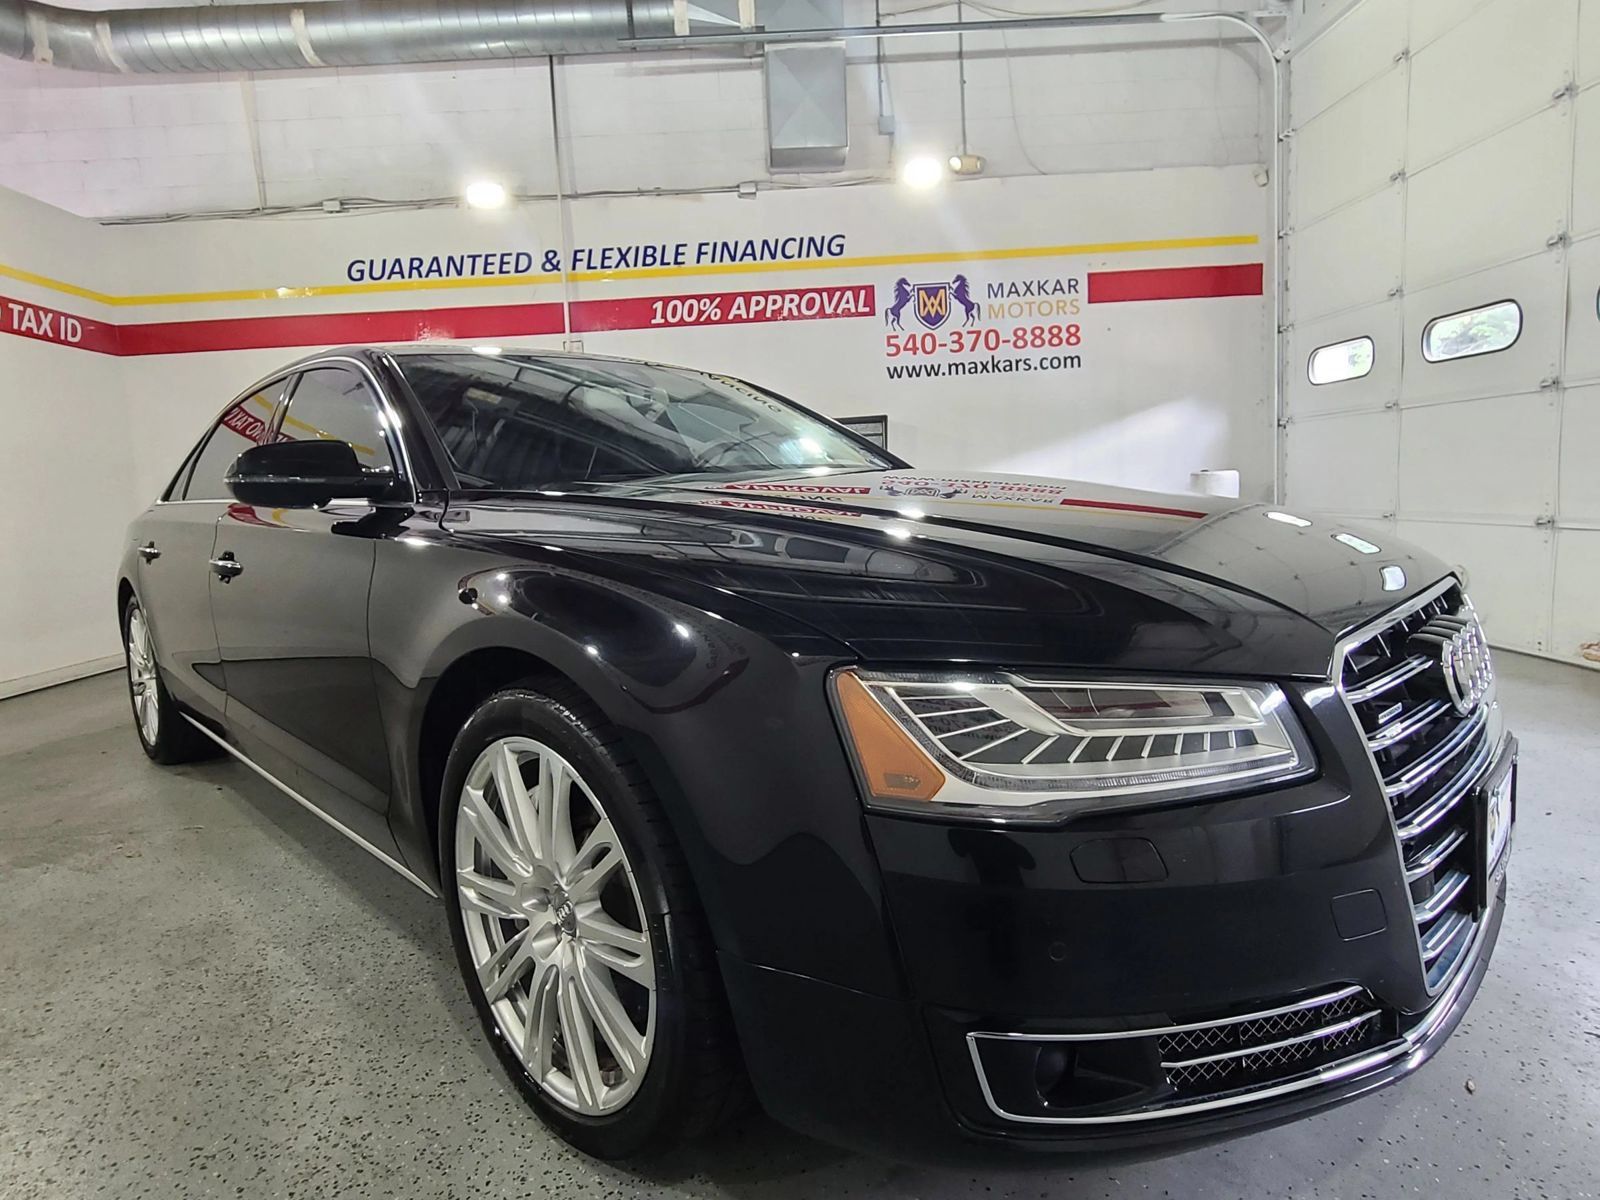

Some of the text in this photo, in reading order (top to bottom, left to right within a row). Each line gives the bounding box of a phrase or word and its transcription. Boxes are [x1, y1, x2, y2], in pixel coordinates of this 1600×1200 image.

[347, 234, 846, 282] GUARANTEED & FLEXIBLE FINANCING
[986, 278, 1080, 299] MAXKAR
[8, 303, 54, 338] TAX
[60, 316, 82, 343] ID
[650, 289, 871, 325] 100% APPROVAL
[987, 298, 1081, 320] MOTORS
[885, 324, 1082, 358] 540-370-8888
[886, 354, 1082, 380] www.maxkars.com
